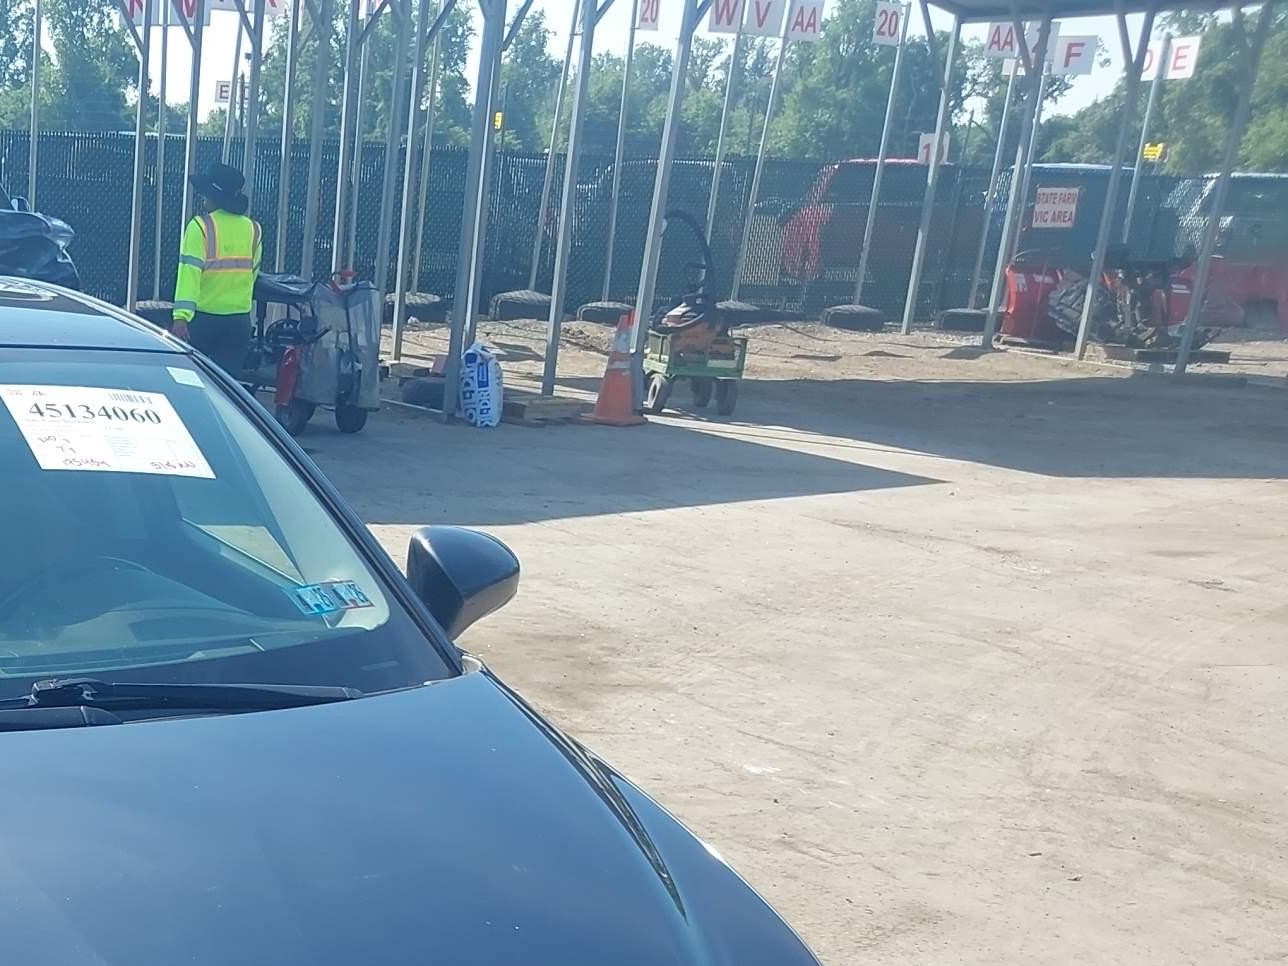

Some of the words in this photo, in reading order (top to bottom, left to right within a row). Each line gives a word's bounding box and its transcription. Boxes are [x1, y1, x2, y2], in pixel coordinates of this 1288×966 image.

[755, 1, 772, 28] V
[791, 6, 817, 33] AA
[876, 9, 899, 37] 20
[988, 25, 1014, 52] AA
[1063, 42, 1086, 68] F
[1172, 45, 1191, 71] E
[219, 84, 230, 99] E
[1051, 210, 1073, 224] AREA
[29, 402, 162, 425] 45134060
